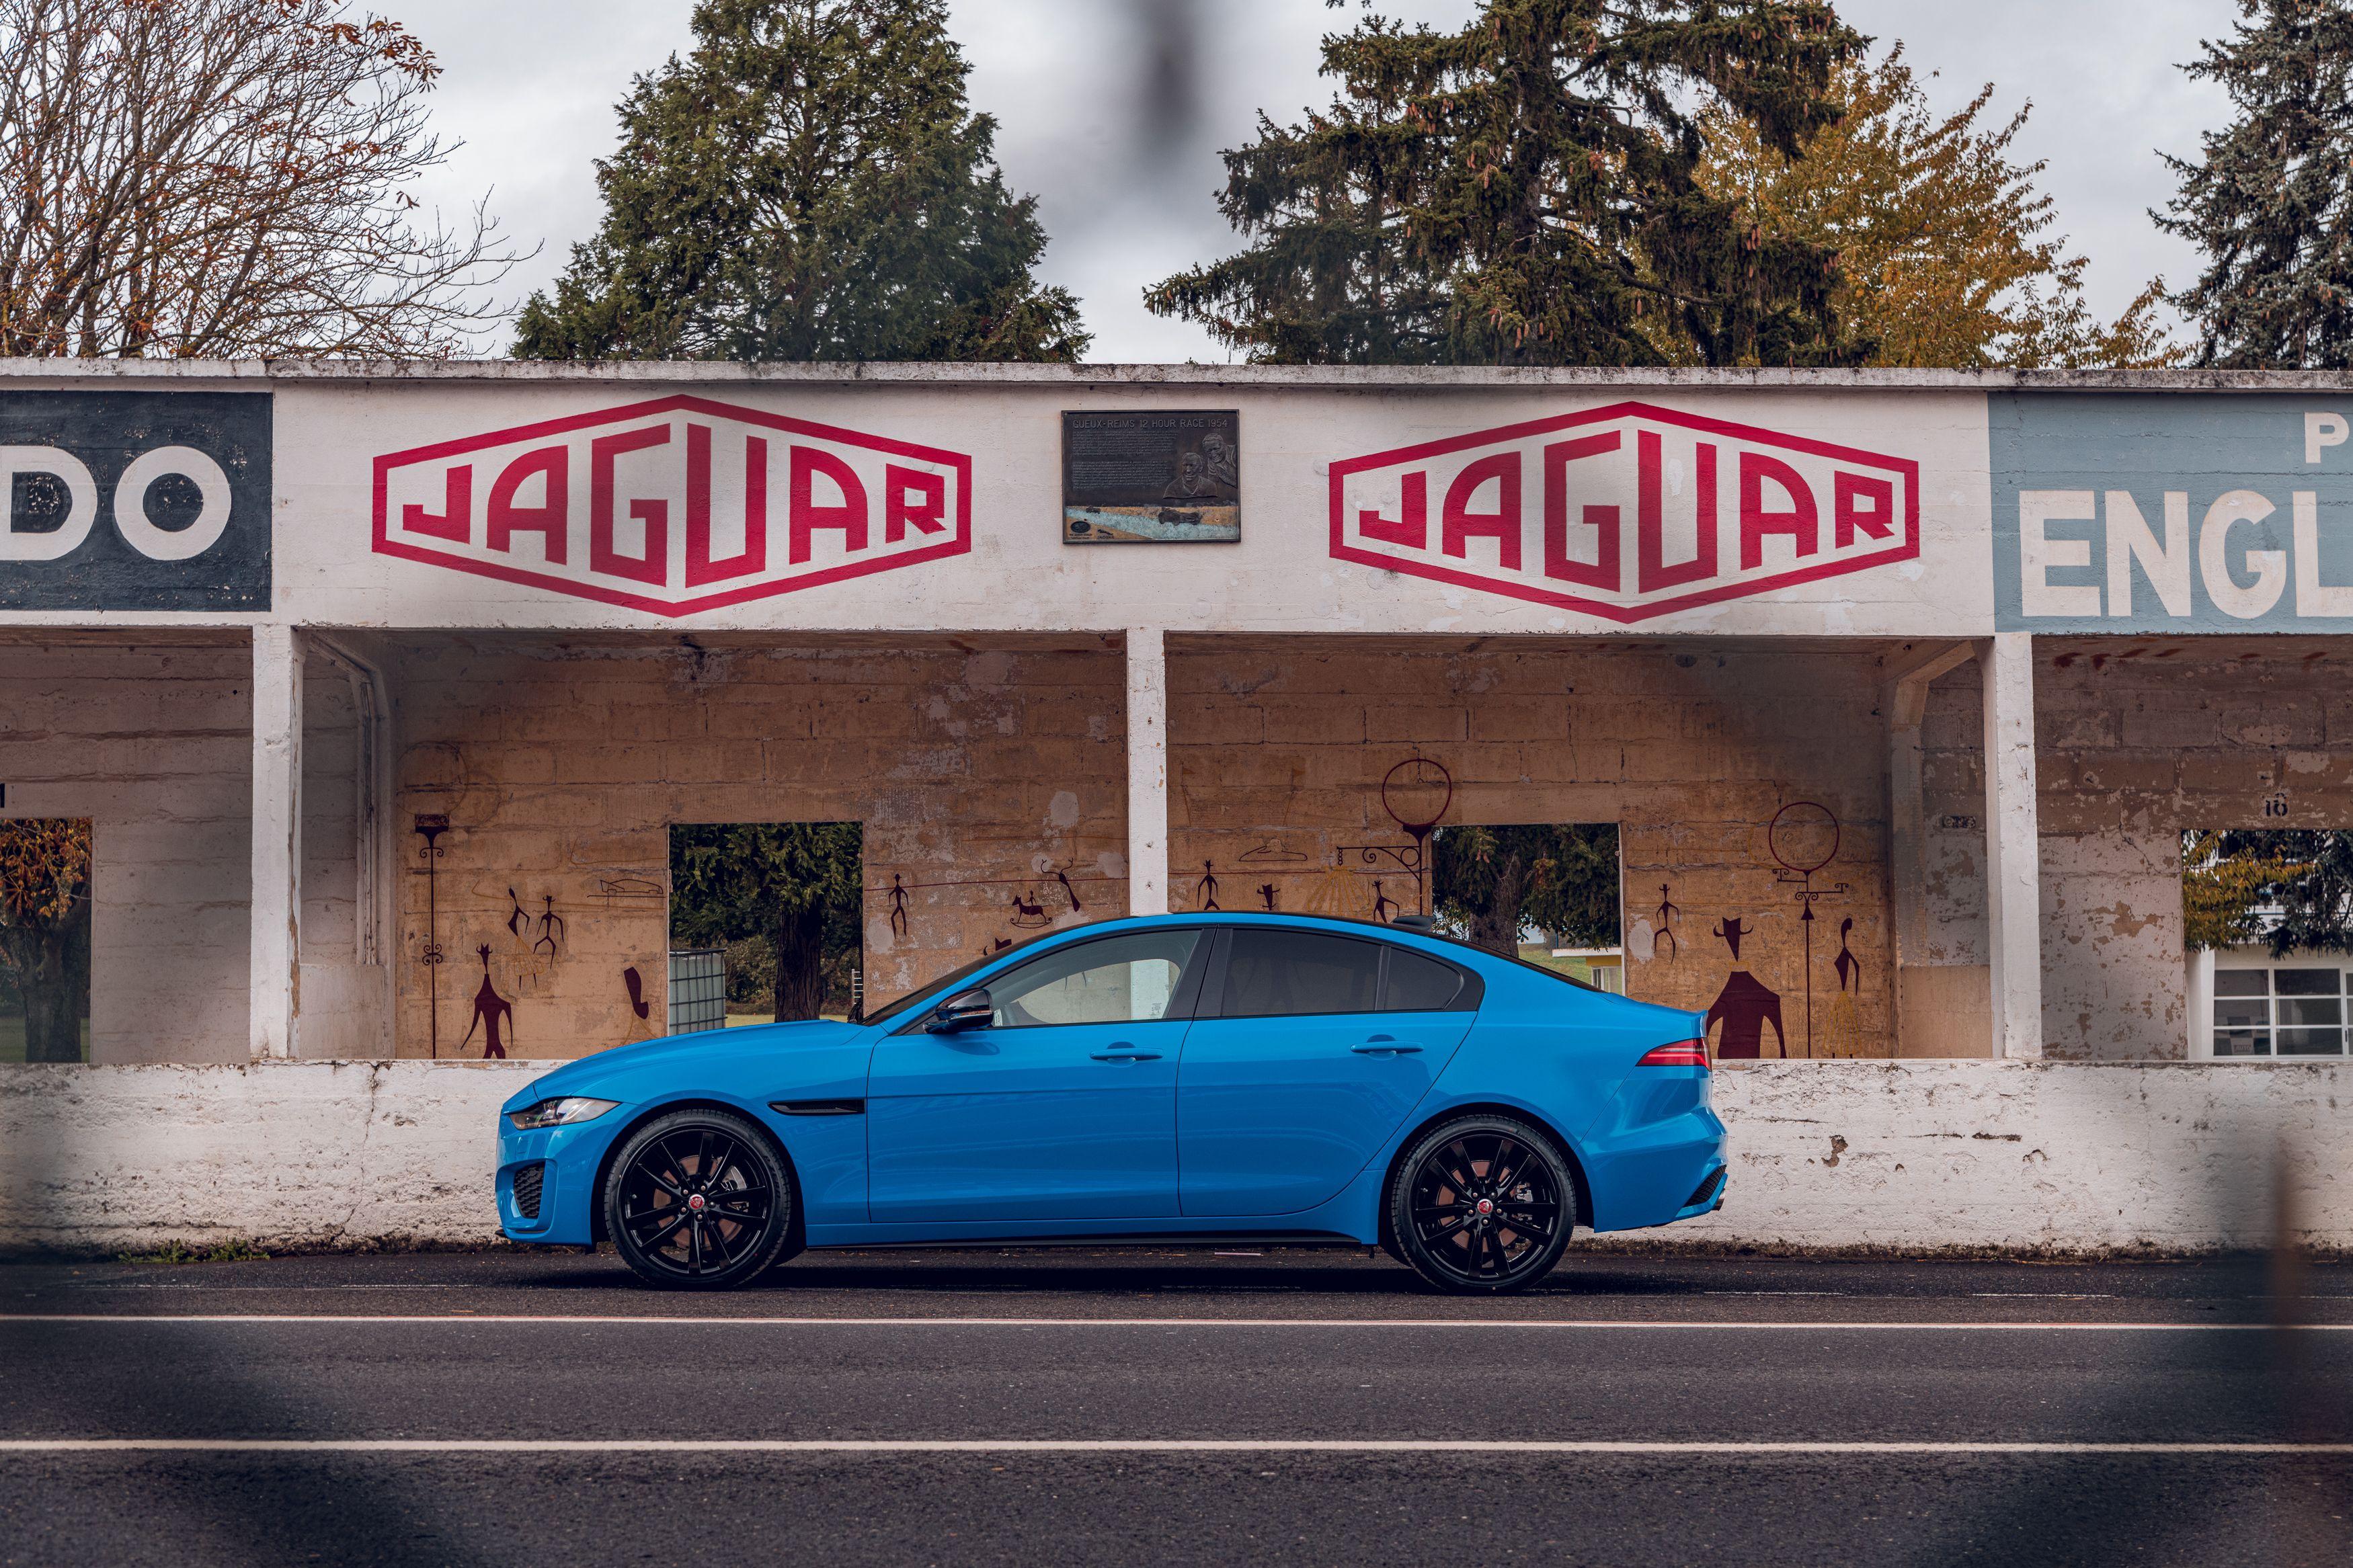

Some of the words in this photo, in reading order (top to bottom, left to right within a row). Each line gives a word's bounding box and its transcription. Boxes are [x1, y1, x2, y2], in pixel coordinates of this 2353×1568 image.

[1140, 420, 1148, 429] 12
[1152, 419, 1176, 428] HOUR
[1180, 419, 1204, 428] RACE
[1208, 419, 1228, 428] 1954
[2304, 411, 2350, 464] P
[0, 445, 232, 561] DO
[403, 424, 946, 588] JAGUAR
[1359, 429, 1894, 593] JAGUAR
[2019, 489, 2353, 619] ENGL
